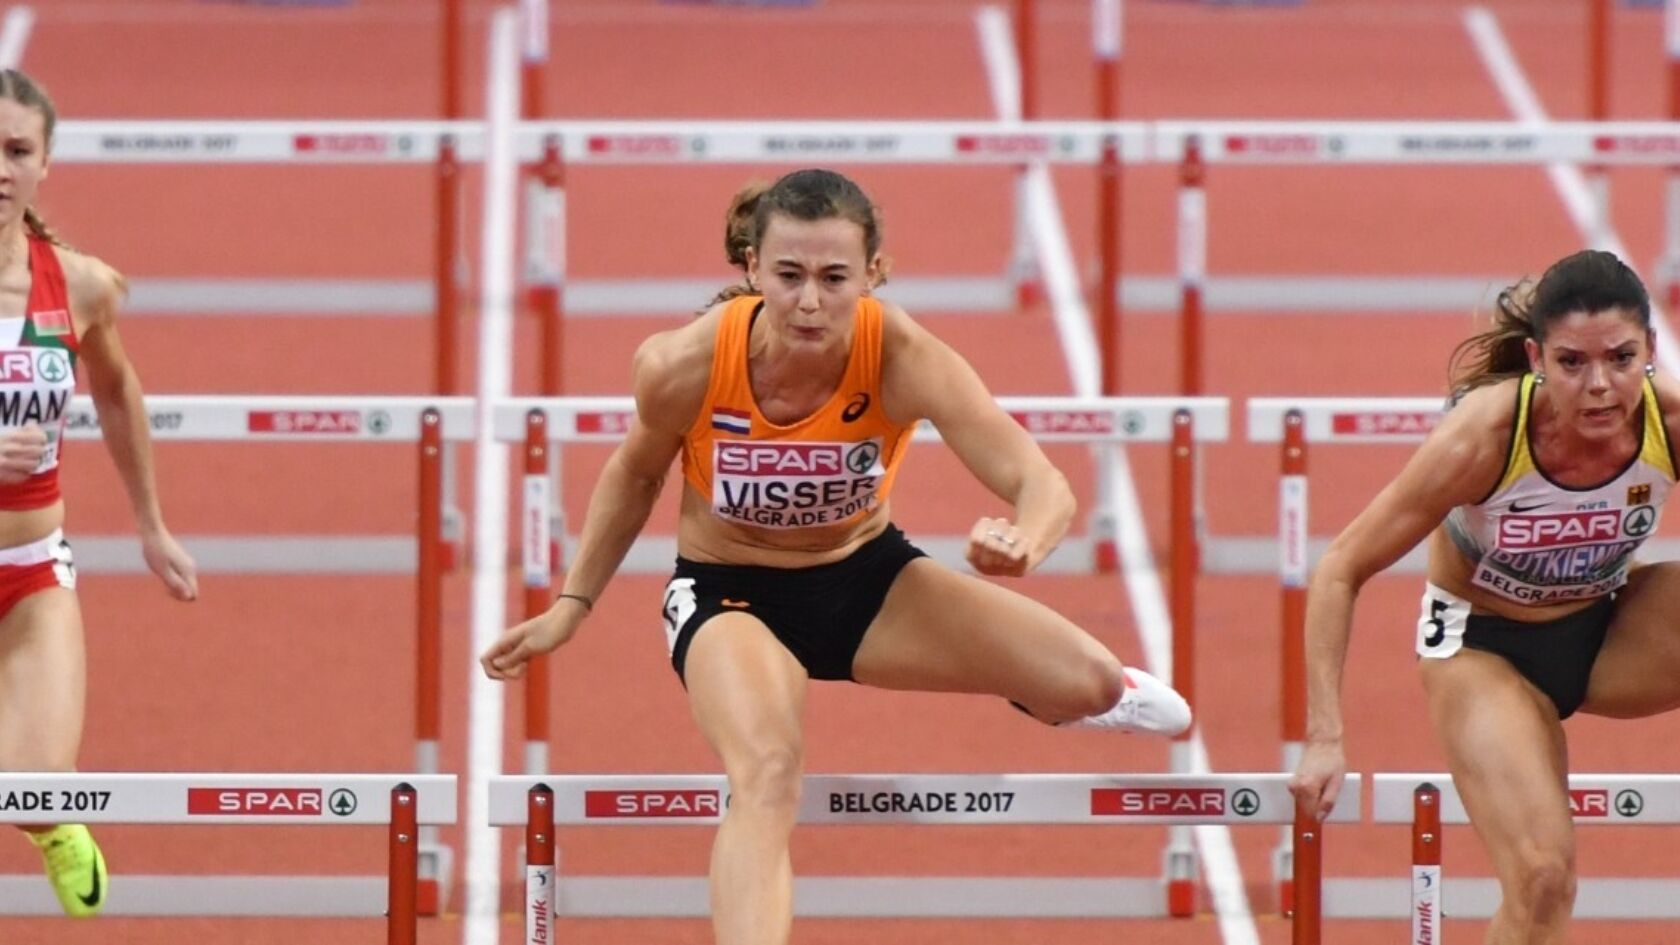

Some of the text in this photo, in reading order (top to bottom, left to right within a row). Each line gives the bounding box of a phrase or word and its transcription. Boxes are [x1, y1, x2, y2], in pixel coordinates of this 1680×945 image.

[275, 411, 359, 433] SPAR
[720, 448, 839, 472] SPAR
[722, 477, 875, 511] VISSER
[1501, 515, 1616, 545] SPAR
[1480, 568, 1585, 601] BELGRADE
[1424, 599, 1445, 648] 5
[0, 791, 112, 811] ADE 2017
[219, 792, 320, 810] SPAR
[616, 794, 718, 813] SPAR
[829, 792, 1015, 813] BELGRADE 2017
[1121, 792, 1223, 811] SPAR
